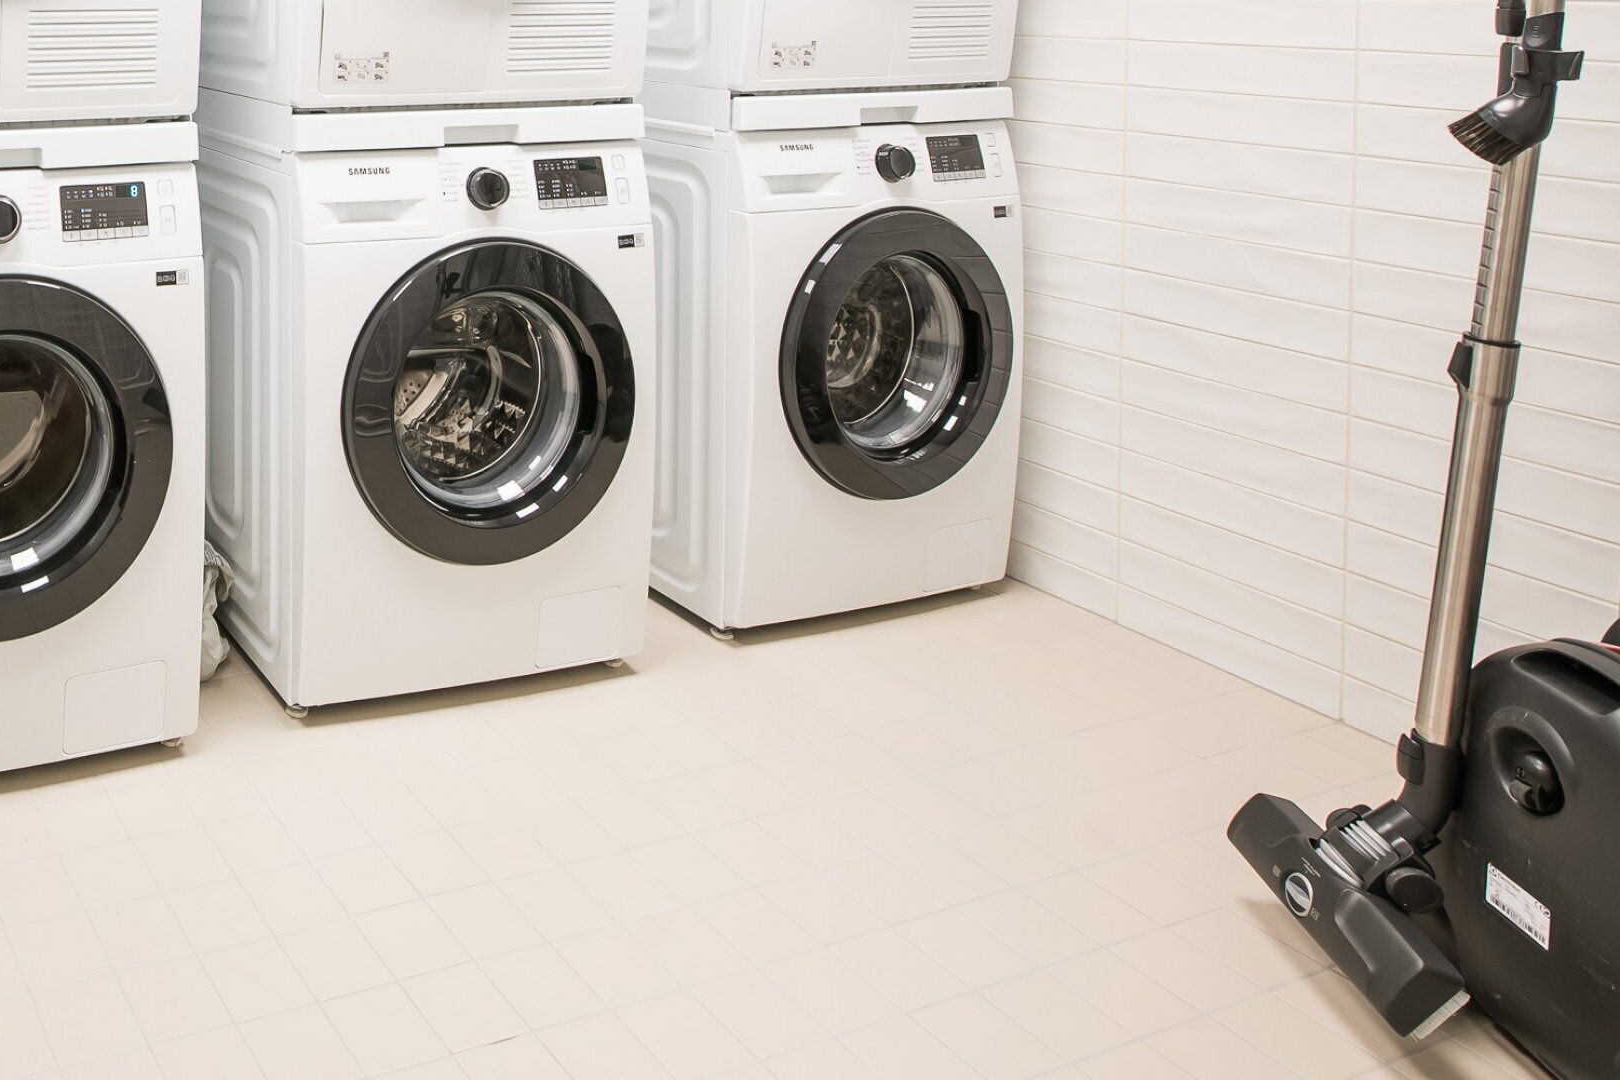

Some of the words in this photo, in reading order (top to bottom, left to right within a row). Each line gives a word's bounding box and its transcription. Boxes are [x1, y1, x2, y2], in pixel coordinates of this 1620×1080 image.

[779, 144, 814, 152] SAMSUNG
[348, 167, 390, 176] SAMSUNG
[130, 185, 138, 197] 8
